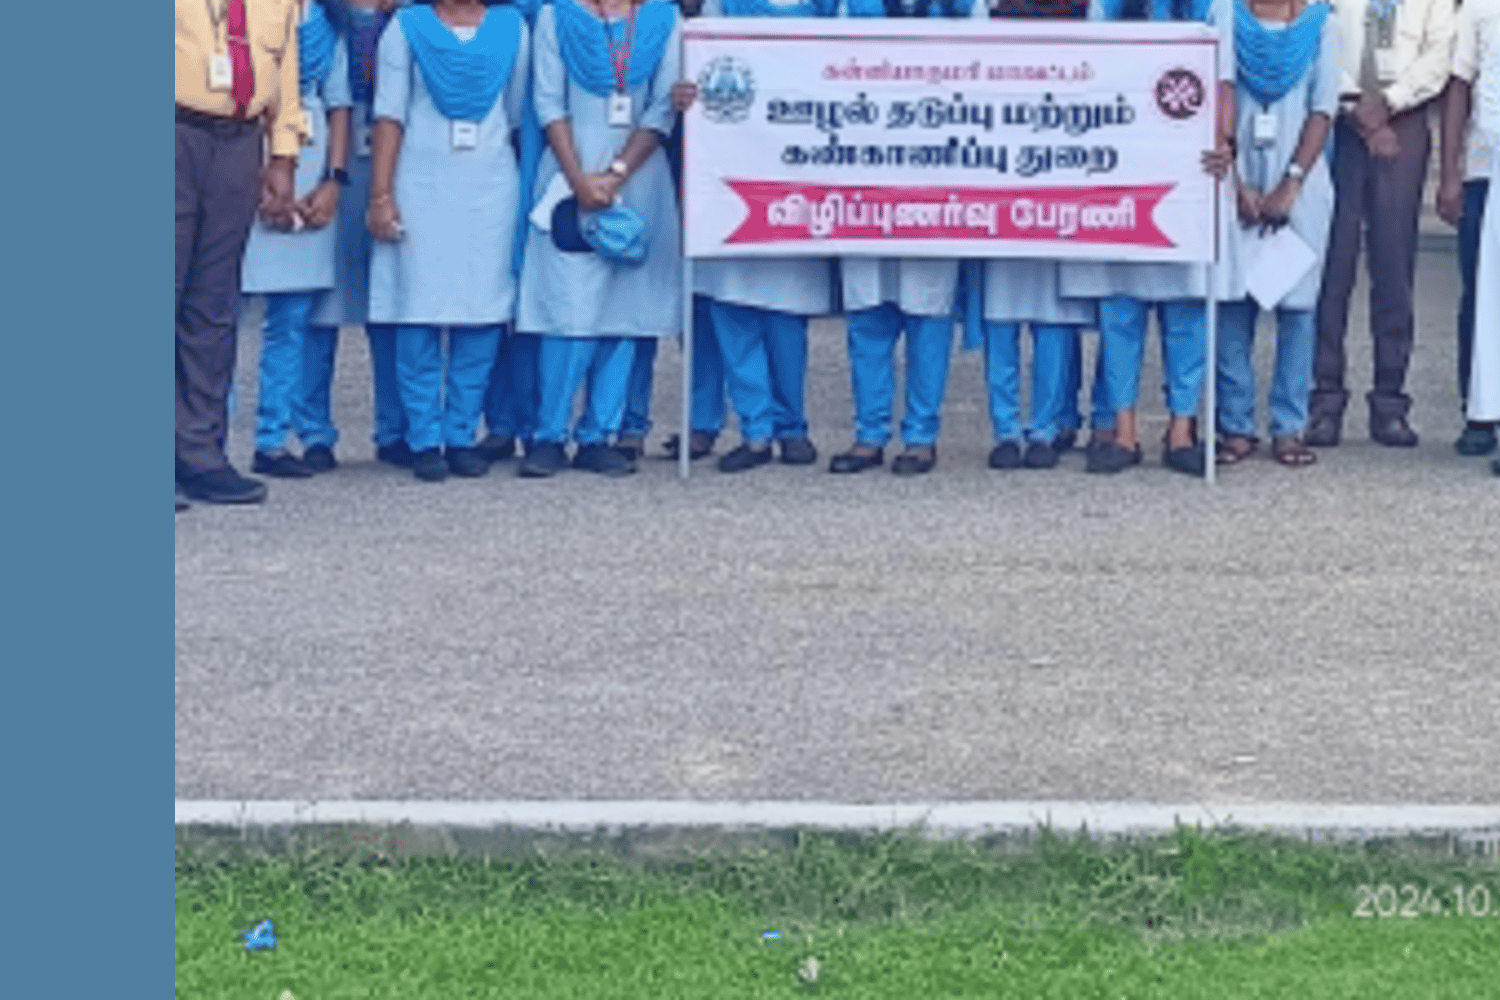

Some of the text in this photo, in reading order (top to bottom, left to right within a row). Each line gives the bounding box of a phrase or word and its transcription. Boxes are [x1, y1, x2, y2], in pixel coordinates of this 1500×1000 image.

[766, 91, 1136, 137] ஊழல் தடுப்பு மற்றும்
[1014, 145, 1119, 178] துறை
[766, 192, 1137, 237] விழிப்புணர்வு பேரணி
